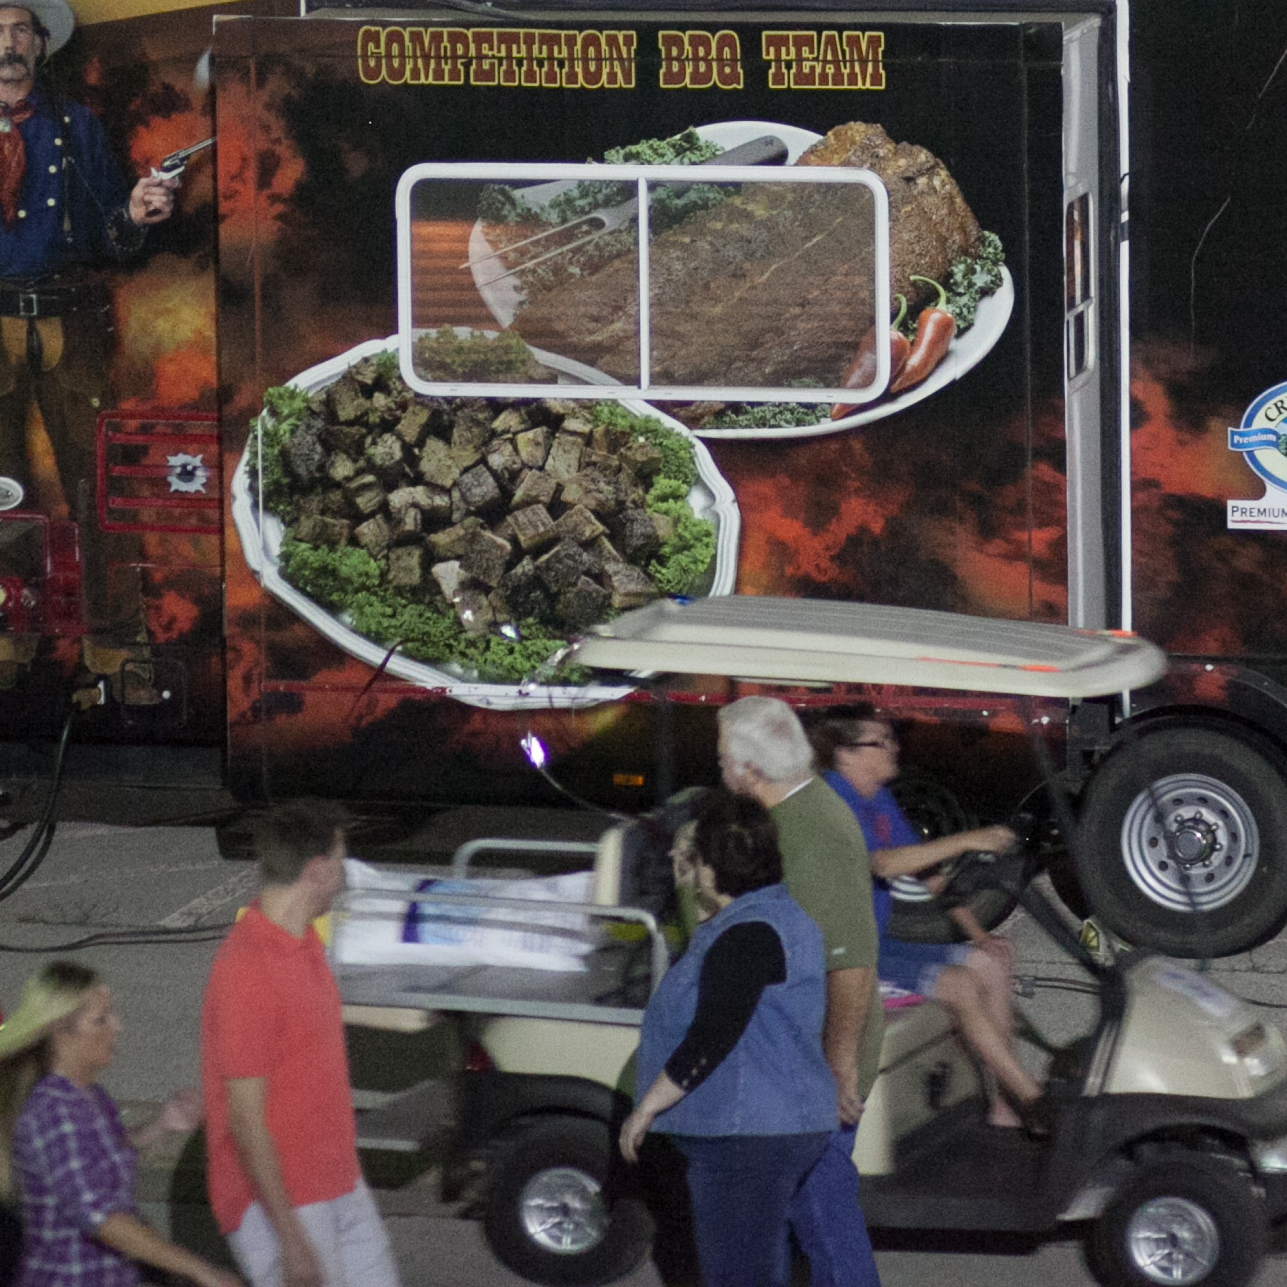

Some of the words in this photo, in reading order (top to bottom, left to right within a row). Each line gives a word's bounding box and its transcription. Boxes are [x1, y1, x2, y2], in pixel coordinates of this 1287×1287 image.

[357, 26, 637, 89] COMPETITION
[658, 29, 744, 90] BBQ
[761, 29, 886, 91] TEAM
[1232, 431, 1278, 445] Premium
